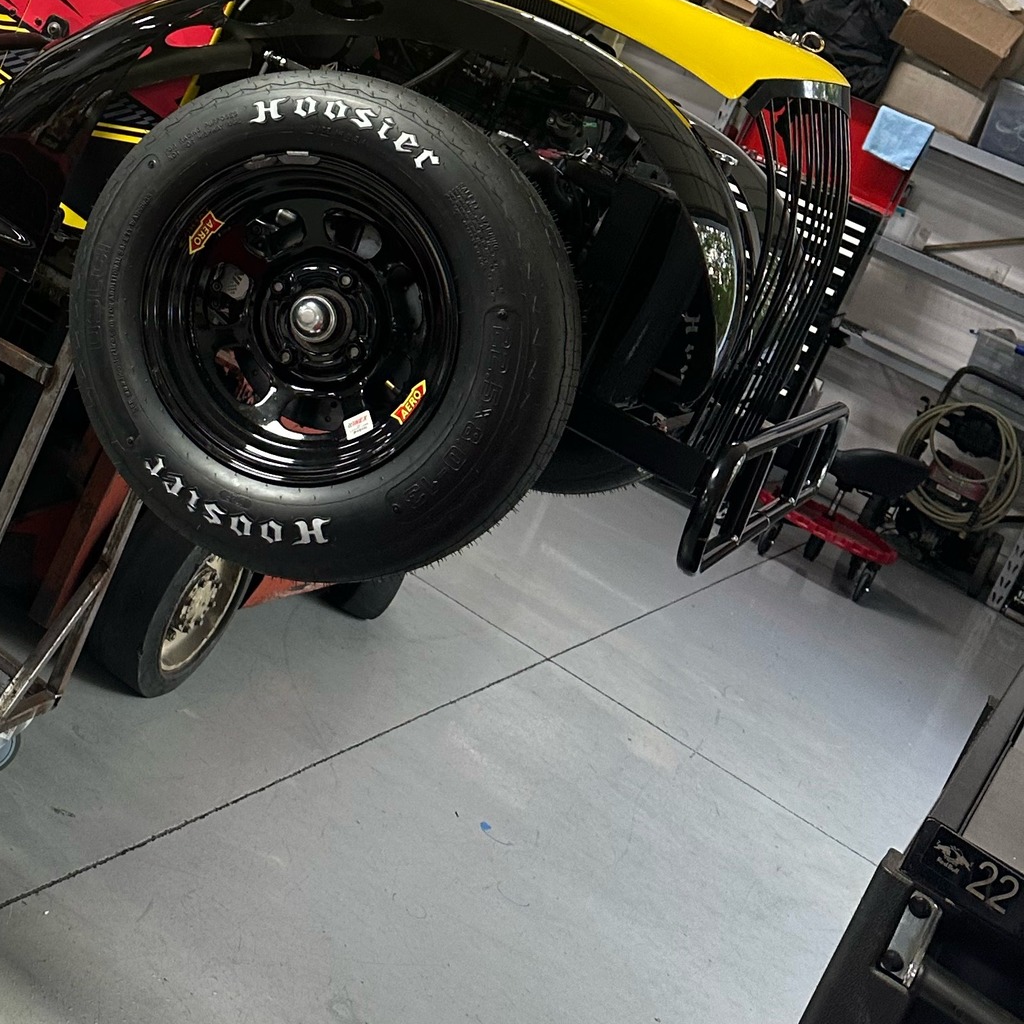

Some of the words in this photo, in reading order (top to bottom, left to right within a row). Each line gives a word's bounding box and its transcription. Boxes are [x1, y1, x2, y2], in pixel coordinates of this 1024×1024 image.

[250, 96, 441, 170] Hoosier
[193, 219, 214, 246] AERO
[400, 390, 422, 419] AERO
[144, 456, 331, 546] Hoosier
[965, 860, 1020, 914] 22
